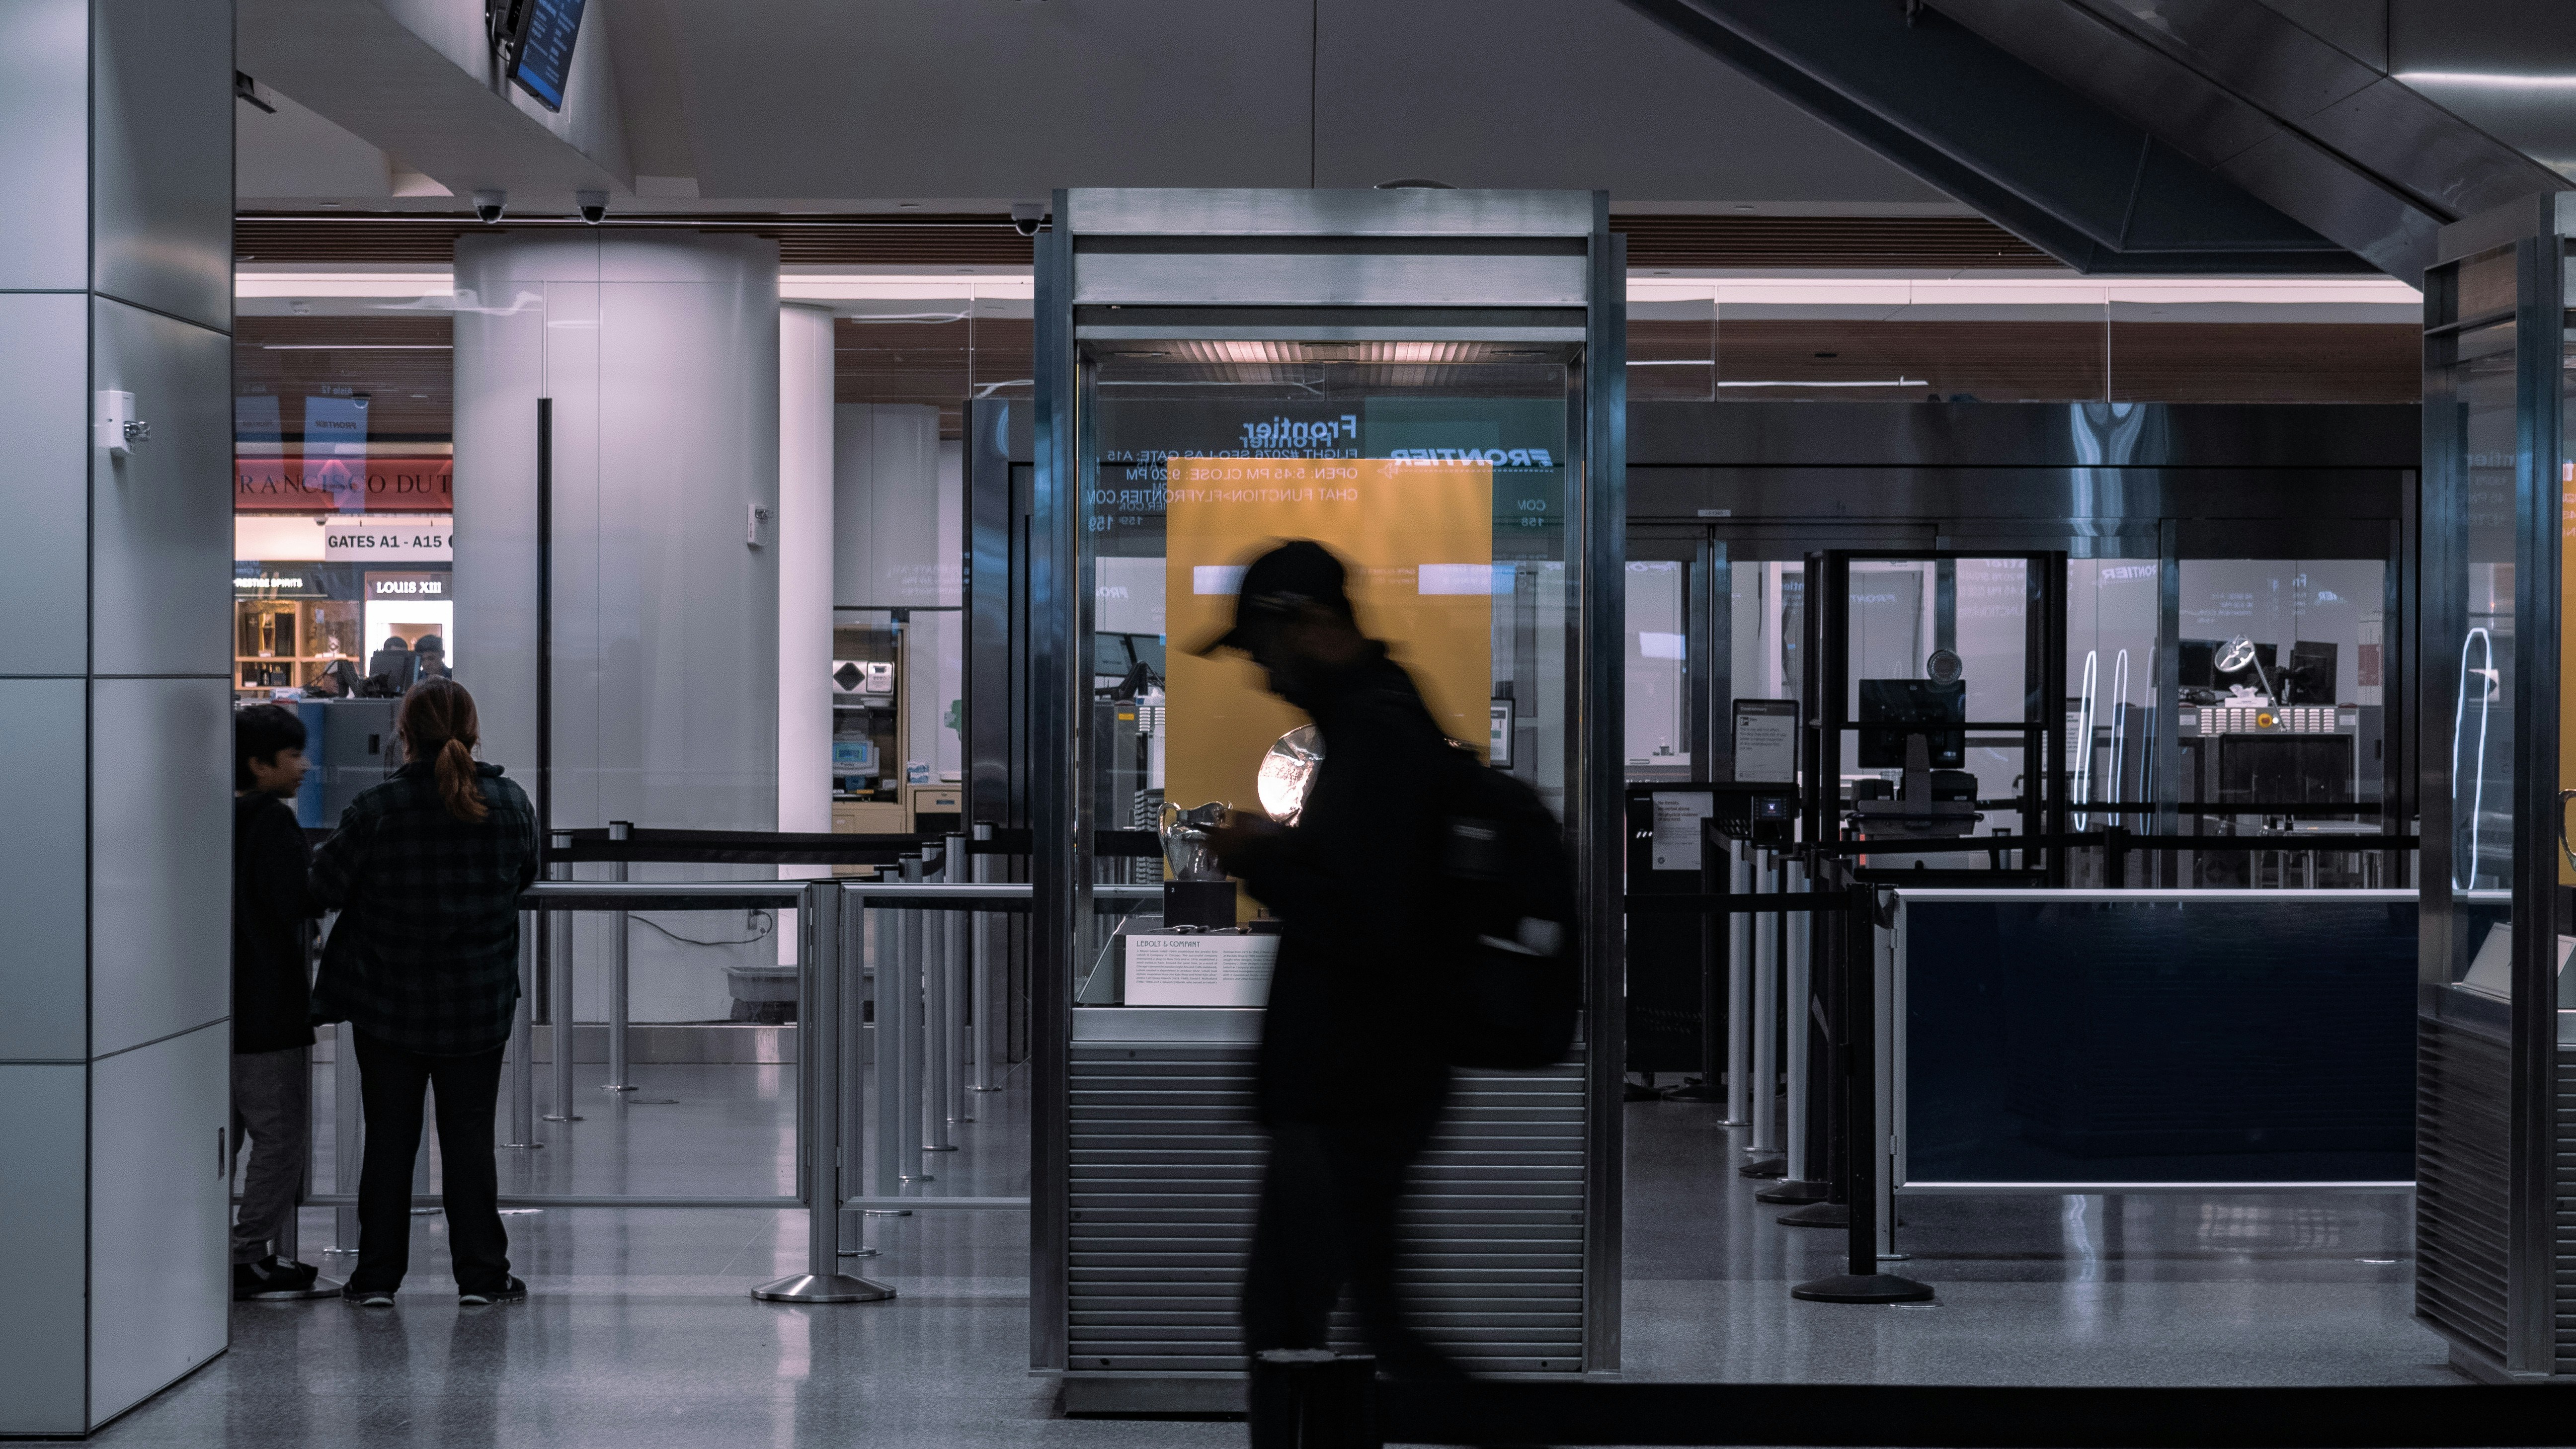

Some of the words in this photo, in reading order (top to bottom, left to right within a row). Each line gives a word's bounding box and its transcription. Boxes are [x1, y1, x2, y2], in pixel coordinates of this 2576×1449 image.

[328, 535, 375, 548] GATES
[380, 536, 401, 548] A1
[413, 536, 442, 548] A15
[376, 581, 417, 594] LOUIS
[419, 581, 442, 594] XIII
